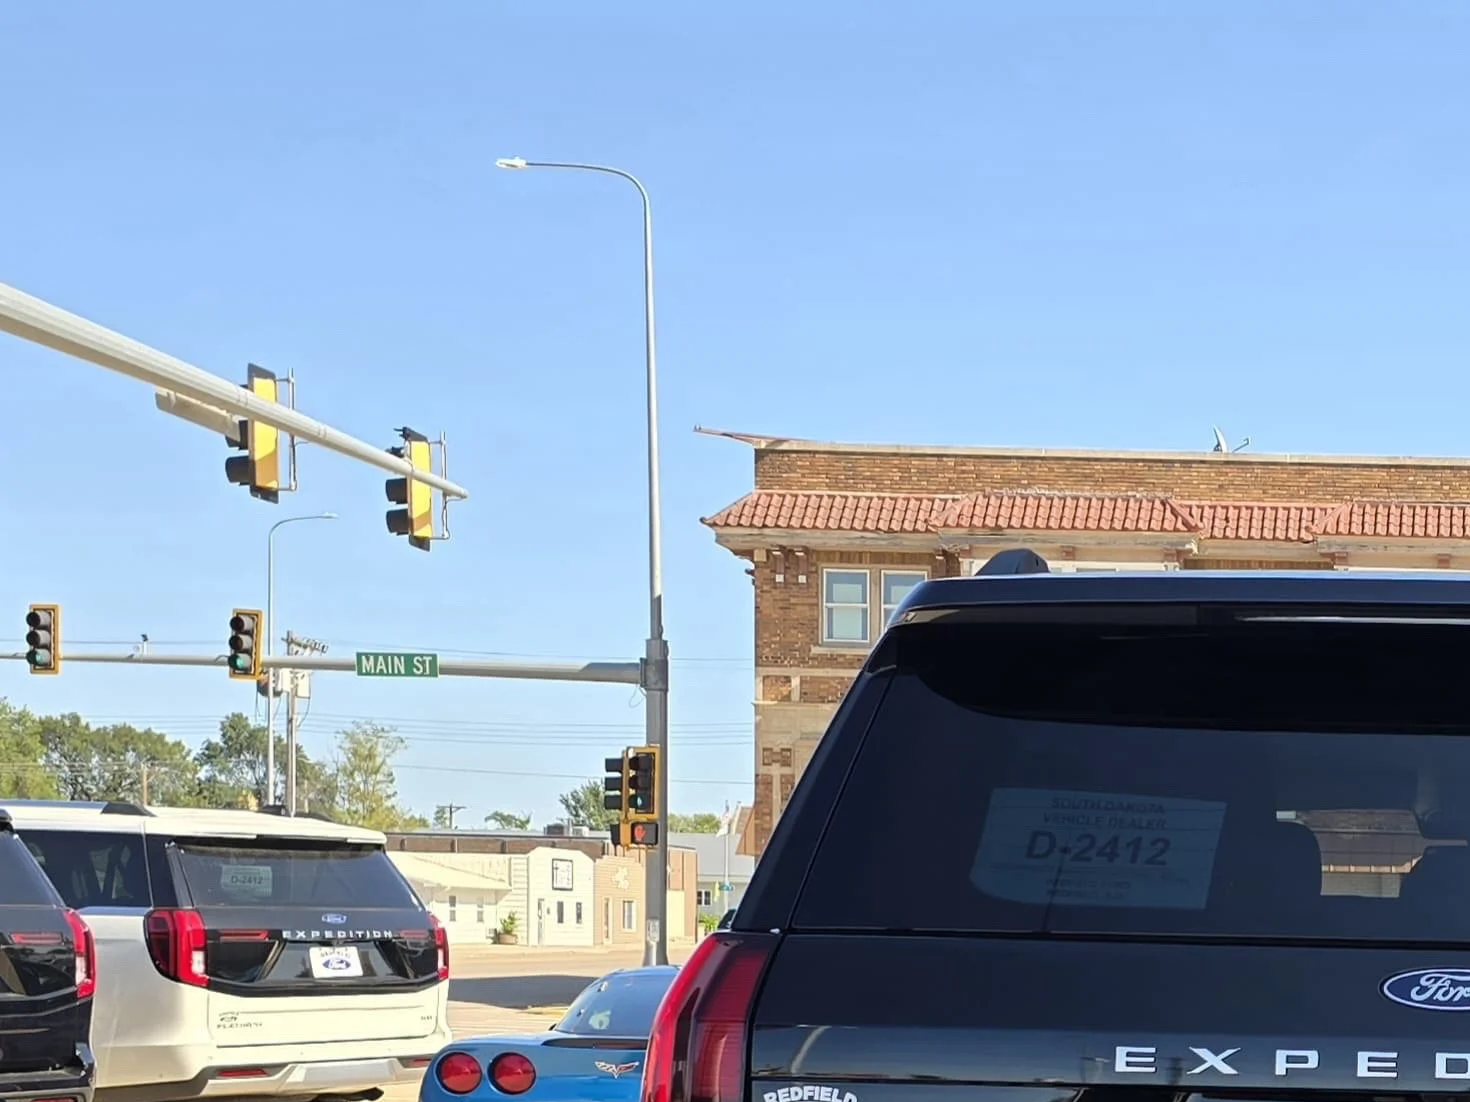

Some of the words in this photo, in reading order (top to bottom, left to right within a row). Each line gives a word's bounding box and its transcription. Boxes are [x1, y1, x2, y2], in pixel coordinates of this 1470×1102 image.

[361, 655, 405, 675] MAIN
[412, 656, 433, 675] ST
[282, 929, 393, 939] EXPEDITION
